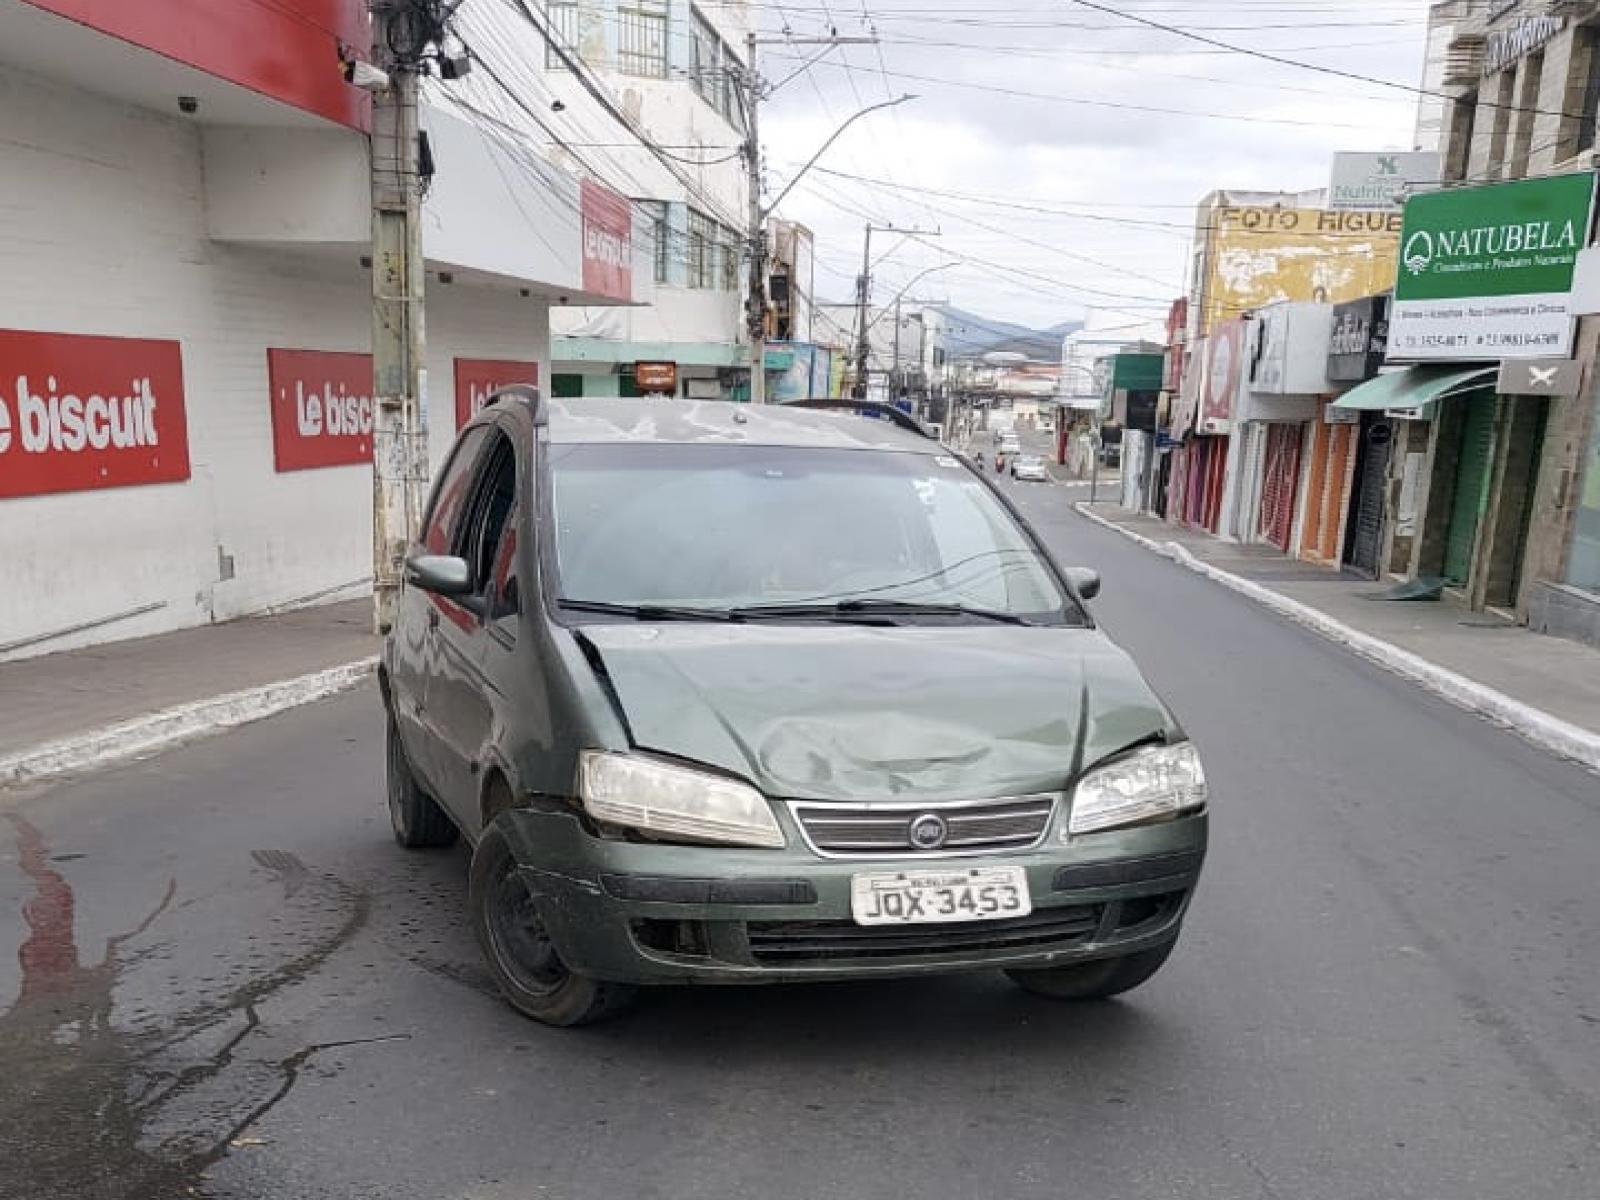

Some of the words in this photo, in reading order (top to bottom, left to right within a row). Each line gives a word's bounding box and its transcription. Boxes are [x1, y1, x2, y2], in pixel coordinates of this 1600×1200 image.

[1221, 207, 1299, 230] FOTO
[1434, 218, 1577, 258] NATUBELA
[16, 375, 159, 452] biscuit
[296, 379, 322, 436] Le
[324, 380, 373, 436] bisc
